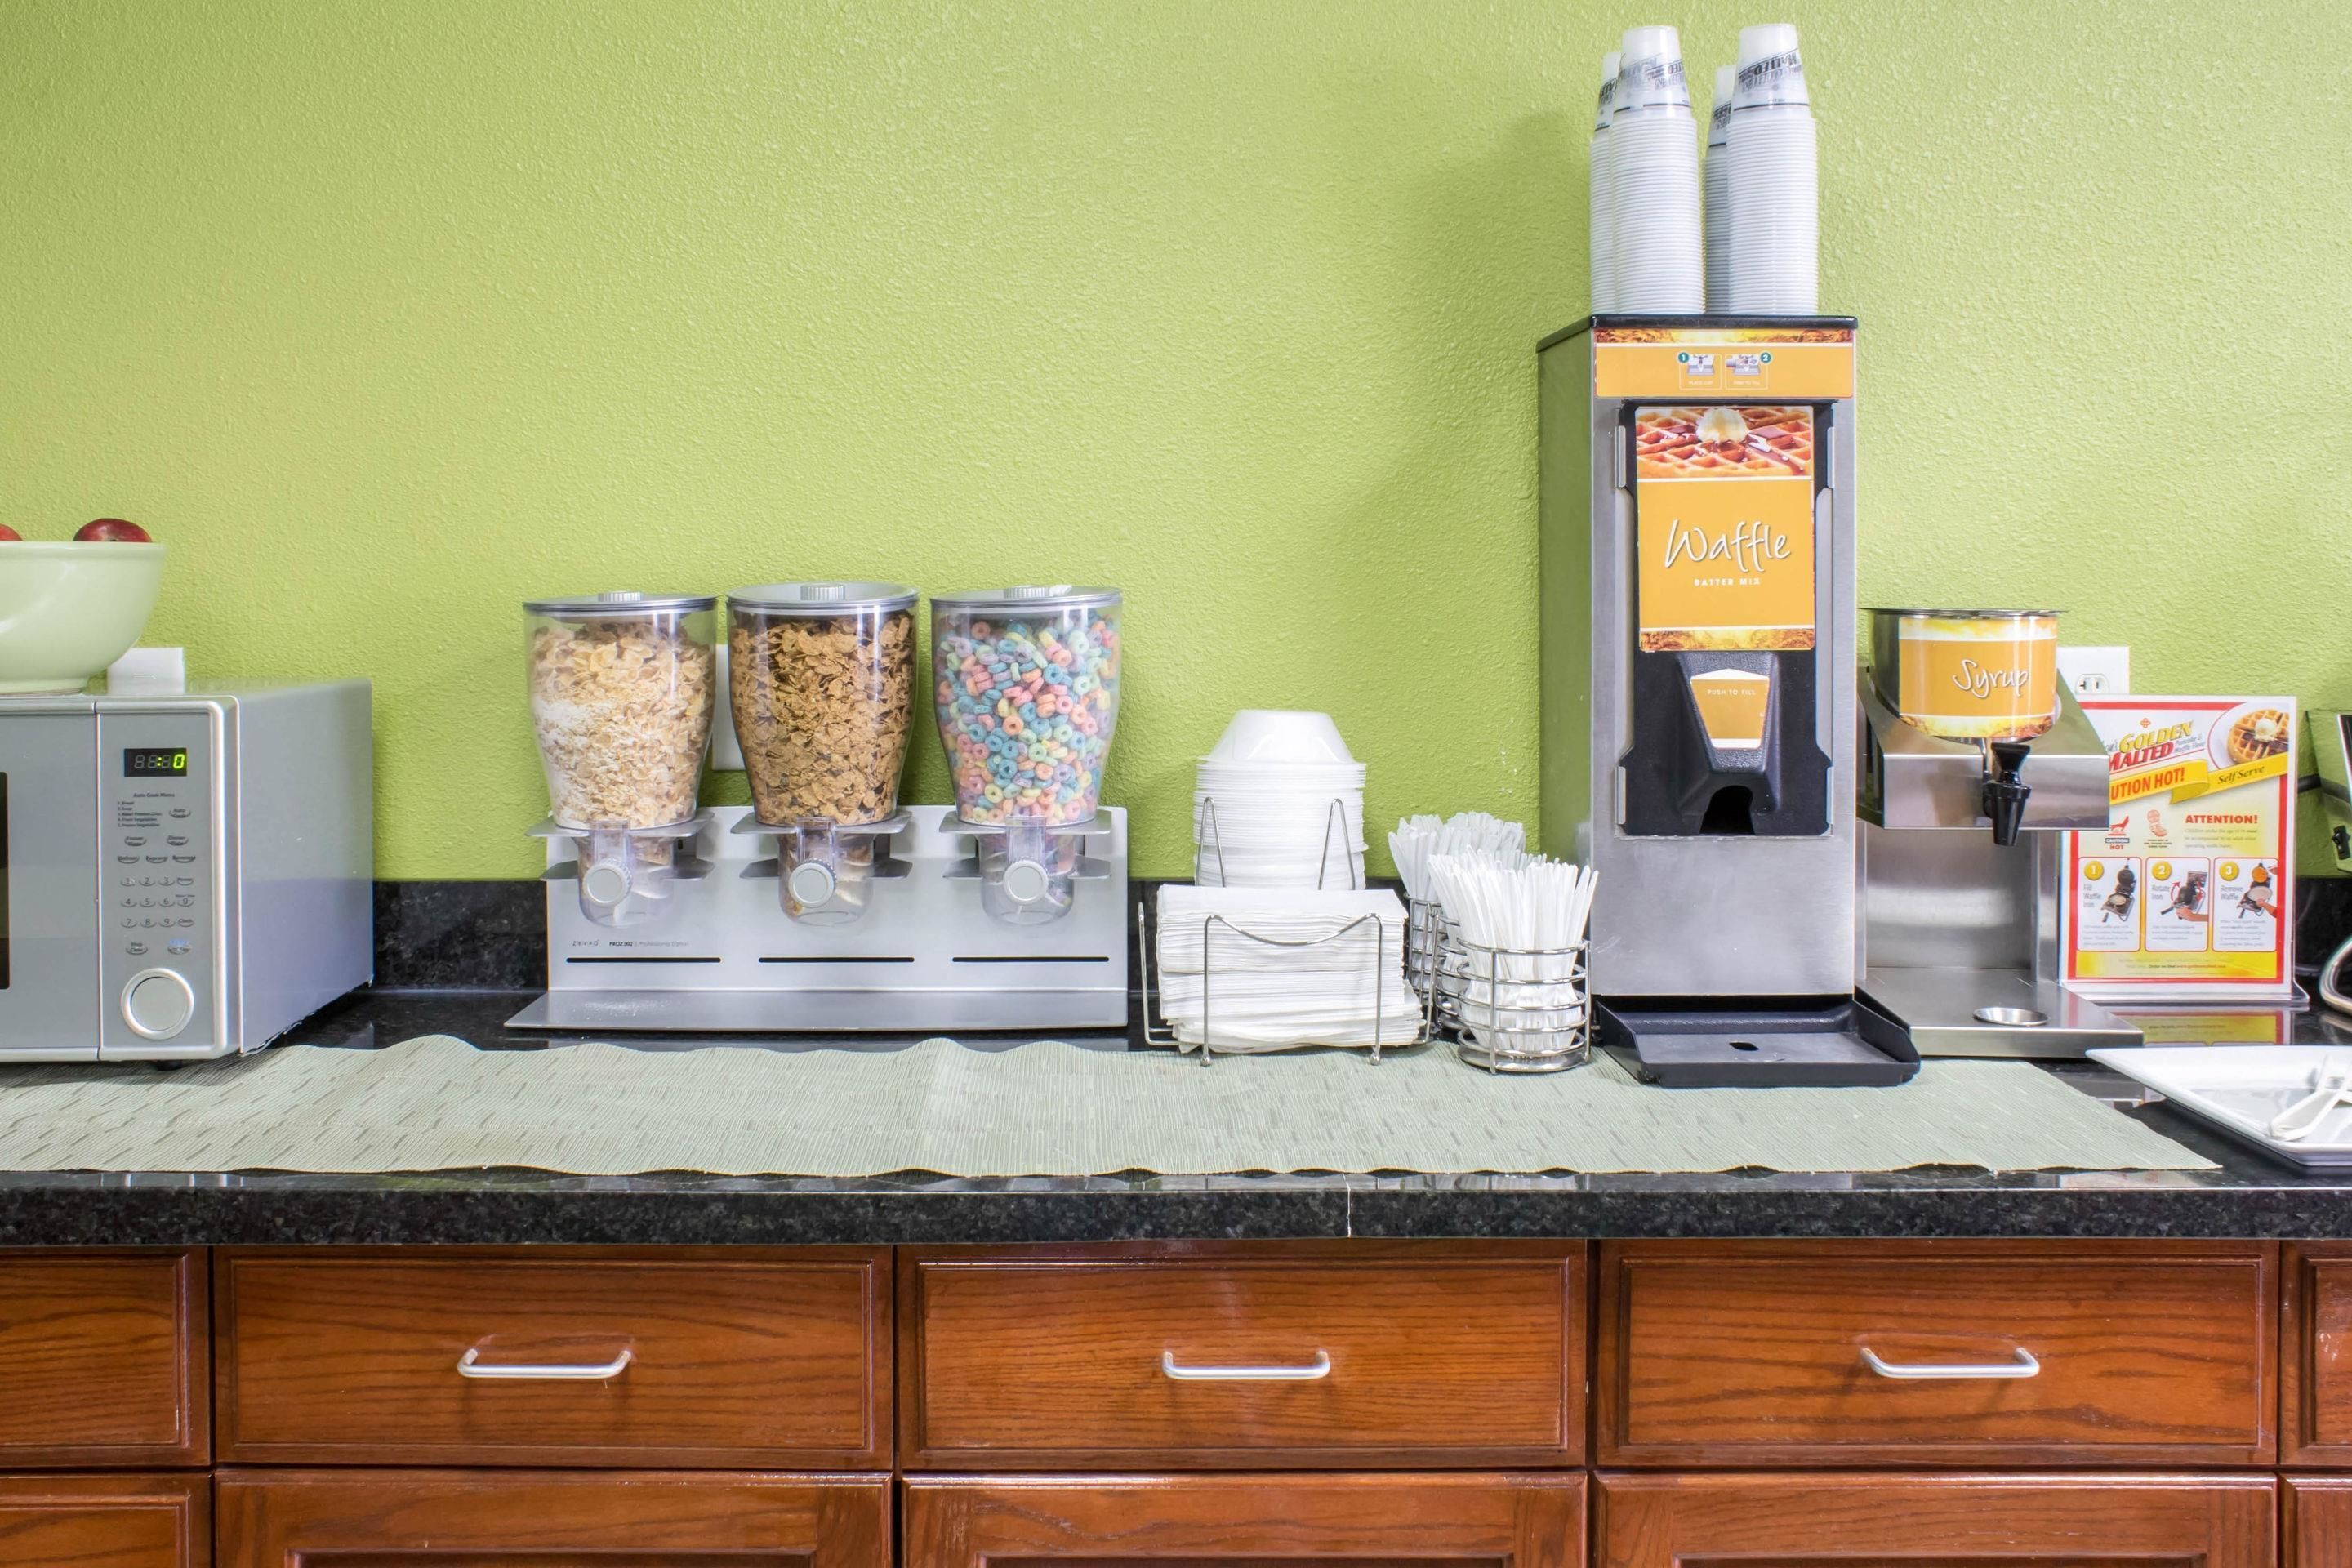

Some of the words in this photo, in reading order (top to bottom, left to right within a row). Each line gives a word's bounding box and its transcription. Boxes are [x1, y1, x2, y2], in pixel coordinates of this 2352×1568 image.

[1762, 354, 1768, 362] 2
[1664, 519, 1791, 572] Waffle
[1694, 578, 1734, 586] BATTER
[1740, 577, 1760, 586] MIX
[1953, 659, 2029, 699] Syrup
[2119, 719, 2194, 754] GOLDEN
[2109, 742, 2175, 771] MALTED
[2217, 770, 2236, 785] Self
[2238, 765, 2265, 780] Serve
[2111, 776, 2151, 800] UTION
[2154, 767, 2185, 789] HOT!
[2185, 814, 2258, 824] ATTENTION!
[2091, 866, 2097, 874] 1
[2158, 866, 2166, 875] 2
[2225, 866, 2233, 875] 3
